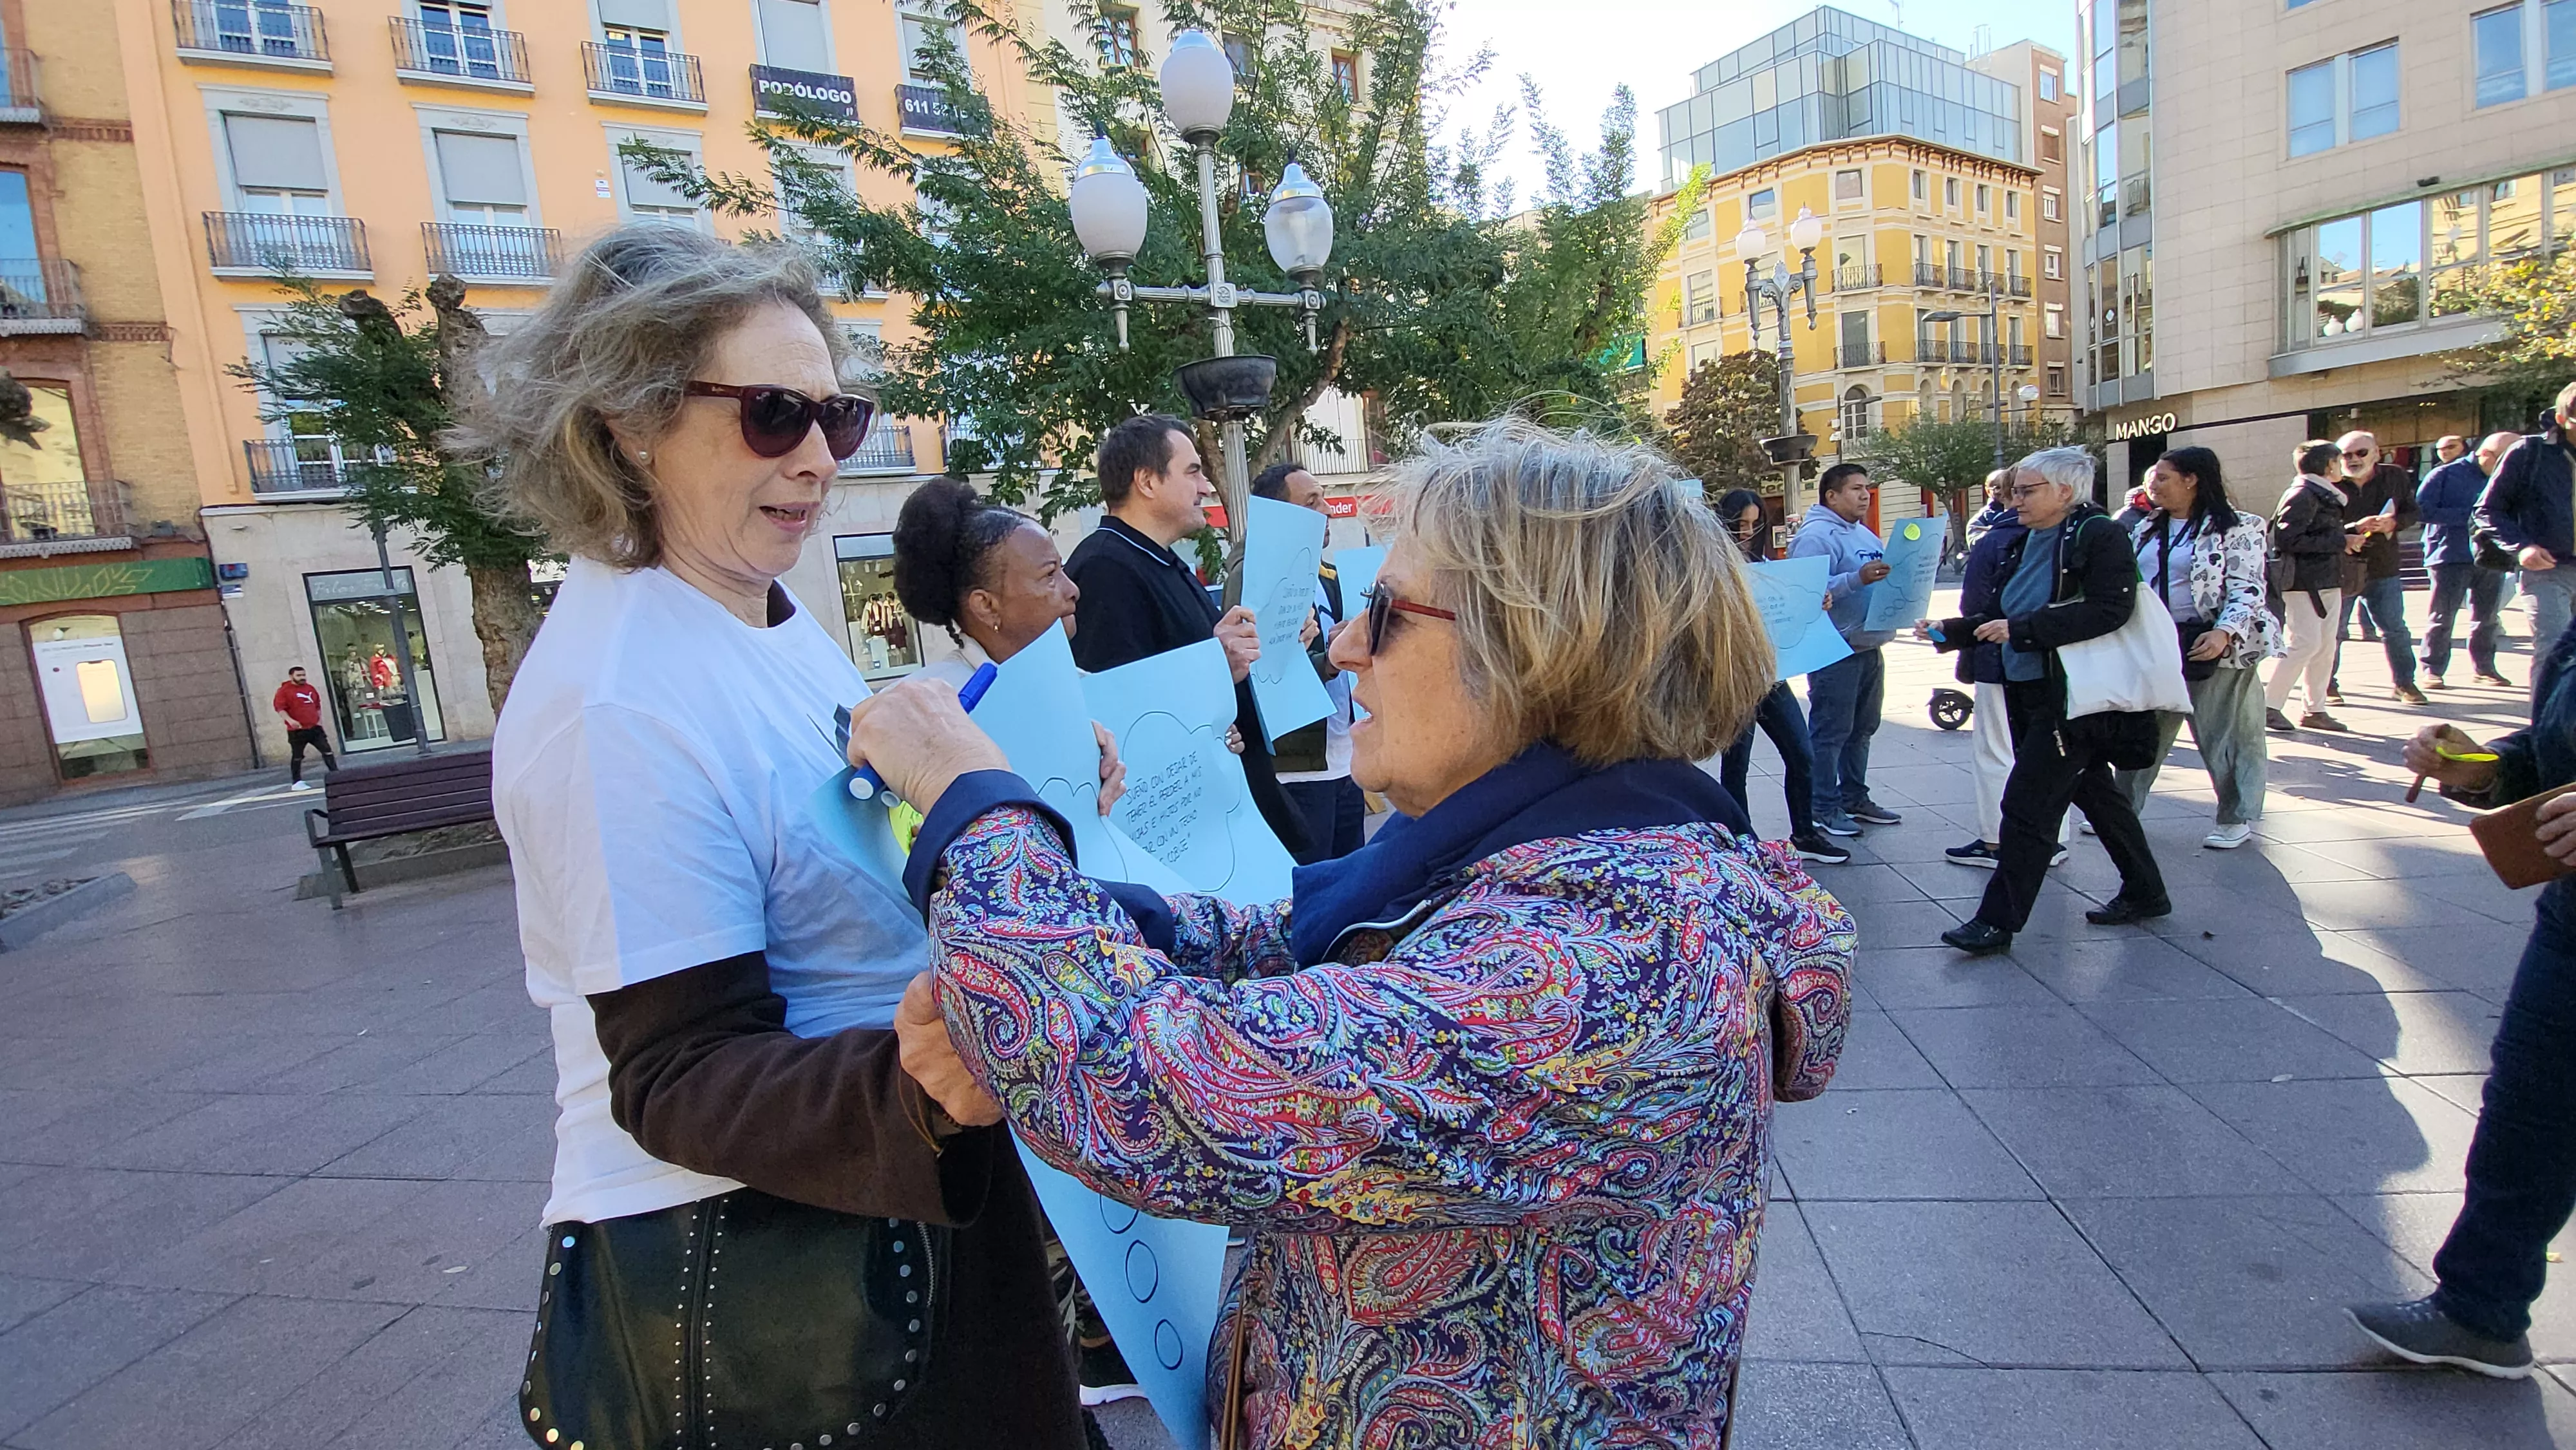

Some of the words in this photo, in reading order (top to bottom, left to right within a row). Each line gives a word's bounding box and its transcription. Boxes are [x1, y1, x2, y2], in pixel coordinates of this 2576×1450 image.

[759, 79, 852, 104] PODÓLOGO
[905, 98, 929, 115] 611
[2116, 412, 2176, 441] MANGO
[1151, 771, 1164, 789] CON
[1166, 756, 1188, 778] DEJAR
[1188, 750, 1198, 766] DE
